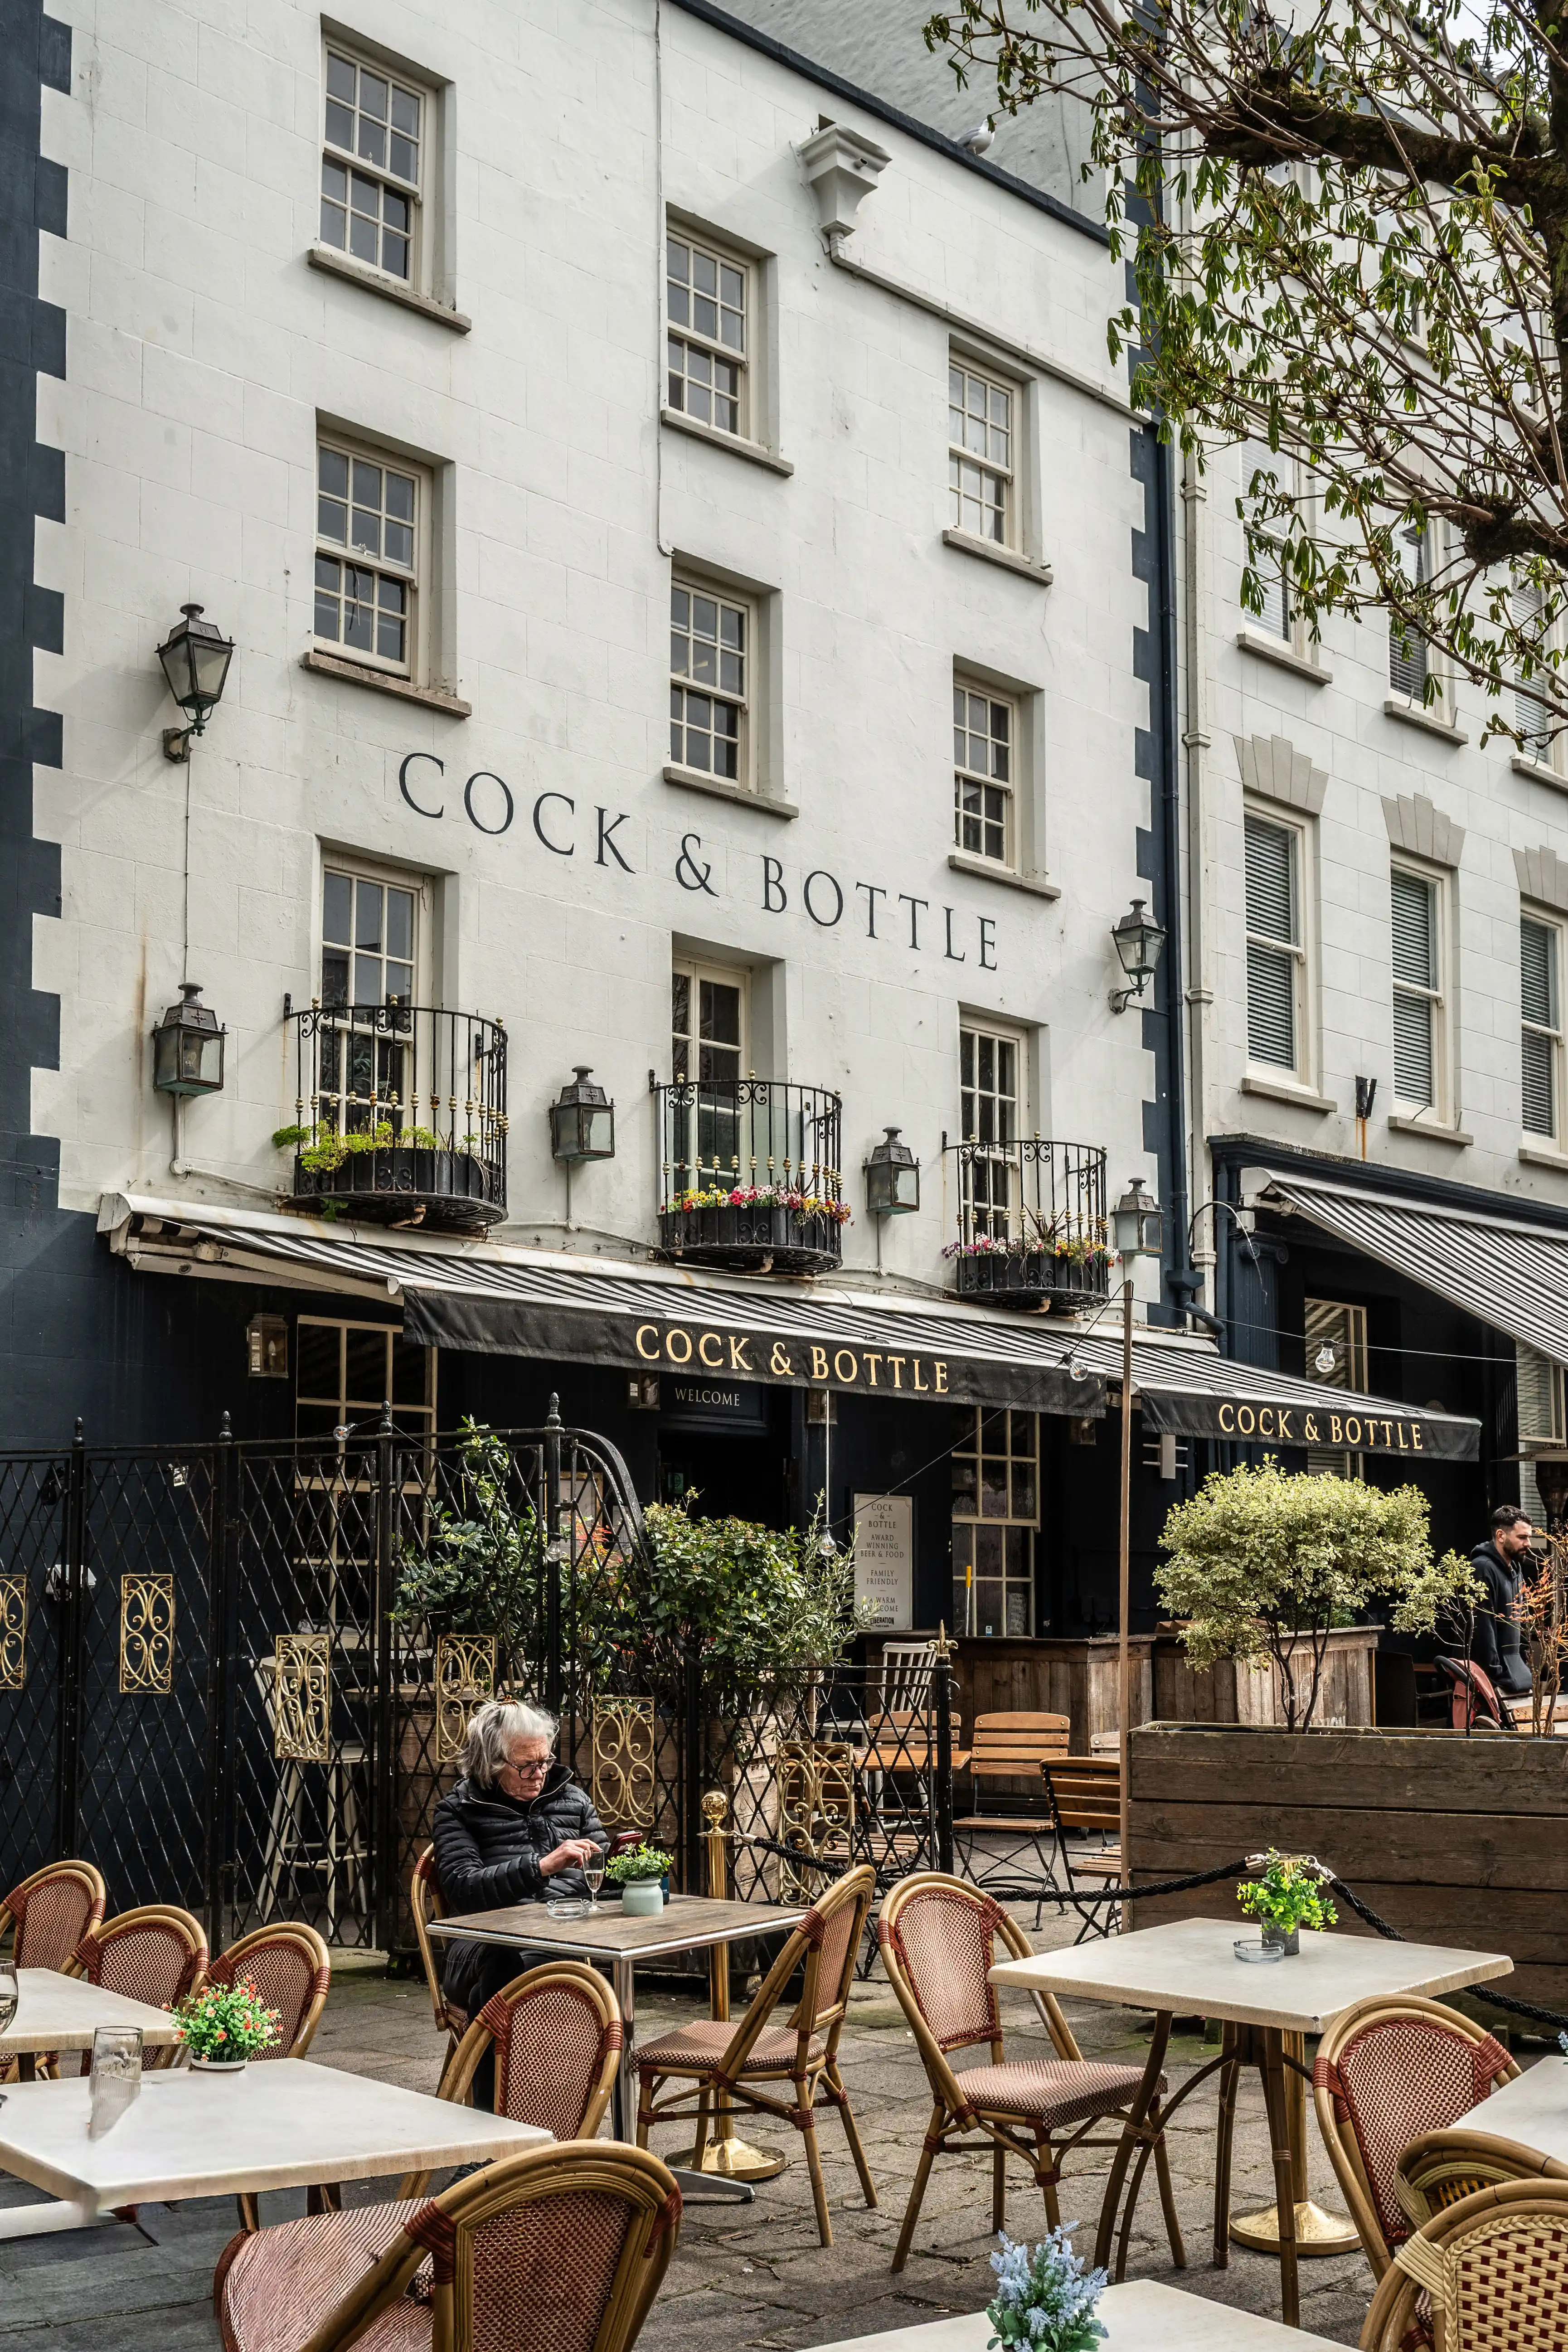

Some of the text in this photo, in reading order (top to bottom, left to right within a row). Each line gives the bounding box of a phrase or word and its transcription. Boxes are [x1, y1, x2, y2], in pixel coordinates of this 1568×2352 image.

[399, 752, 997, 971] COCK & BOTTLE
[636, 1325, 949, 1393] COCK & BOTTLE
[675, 1388, 740, 1406] WELCOME
[1218, 1404, 1422, 1450] COCK & BOTTLE
[871, 1503, 893, 1511] COCK
[870, 1617, 894, 1625] LIBERATION
